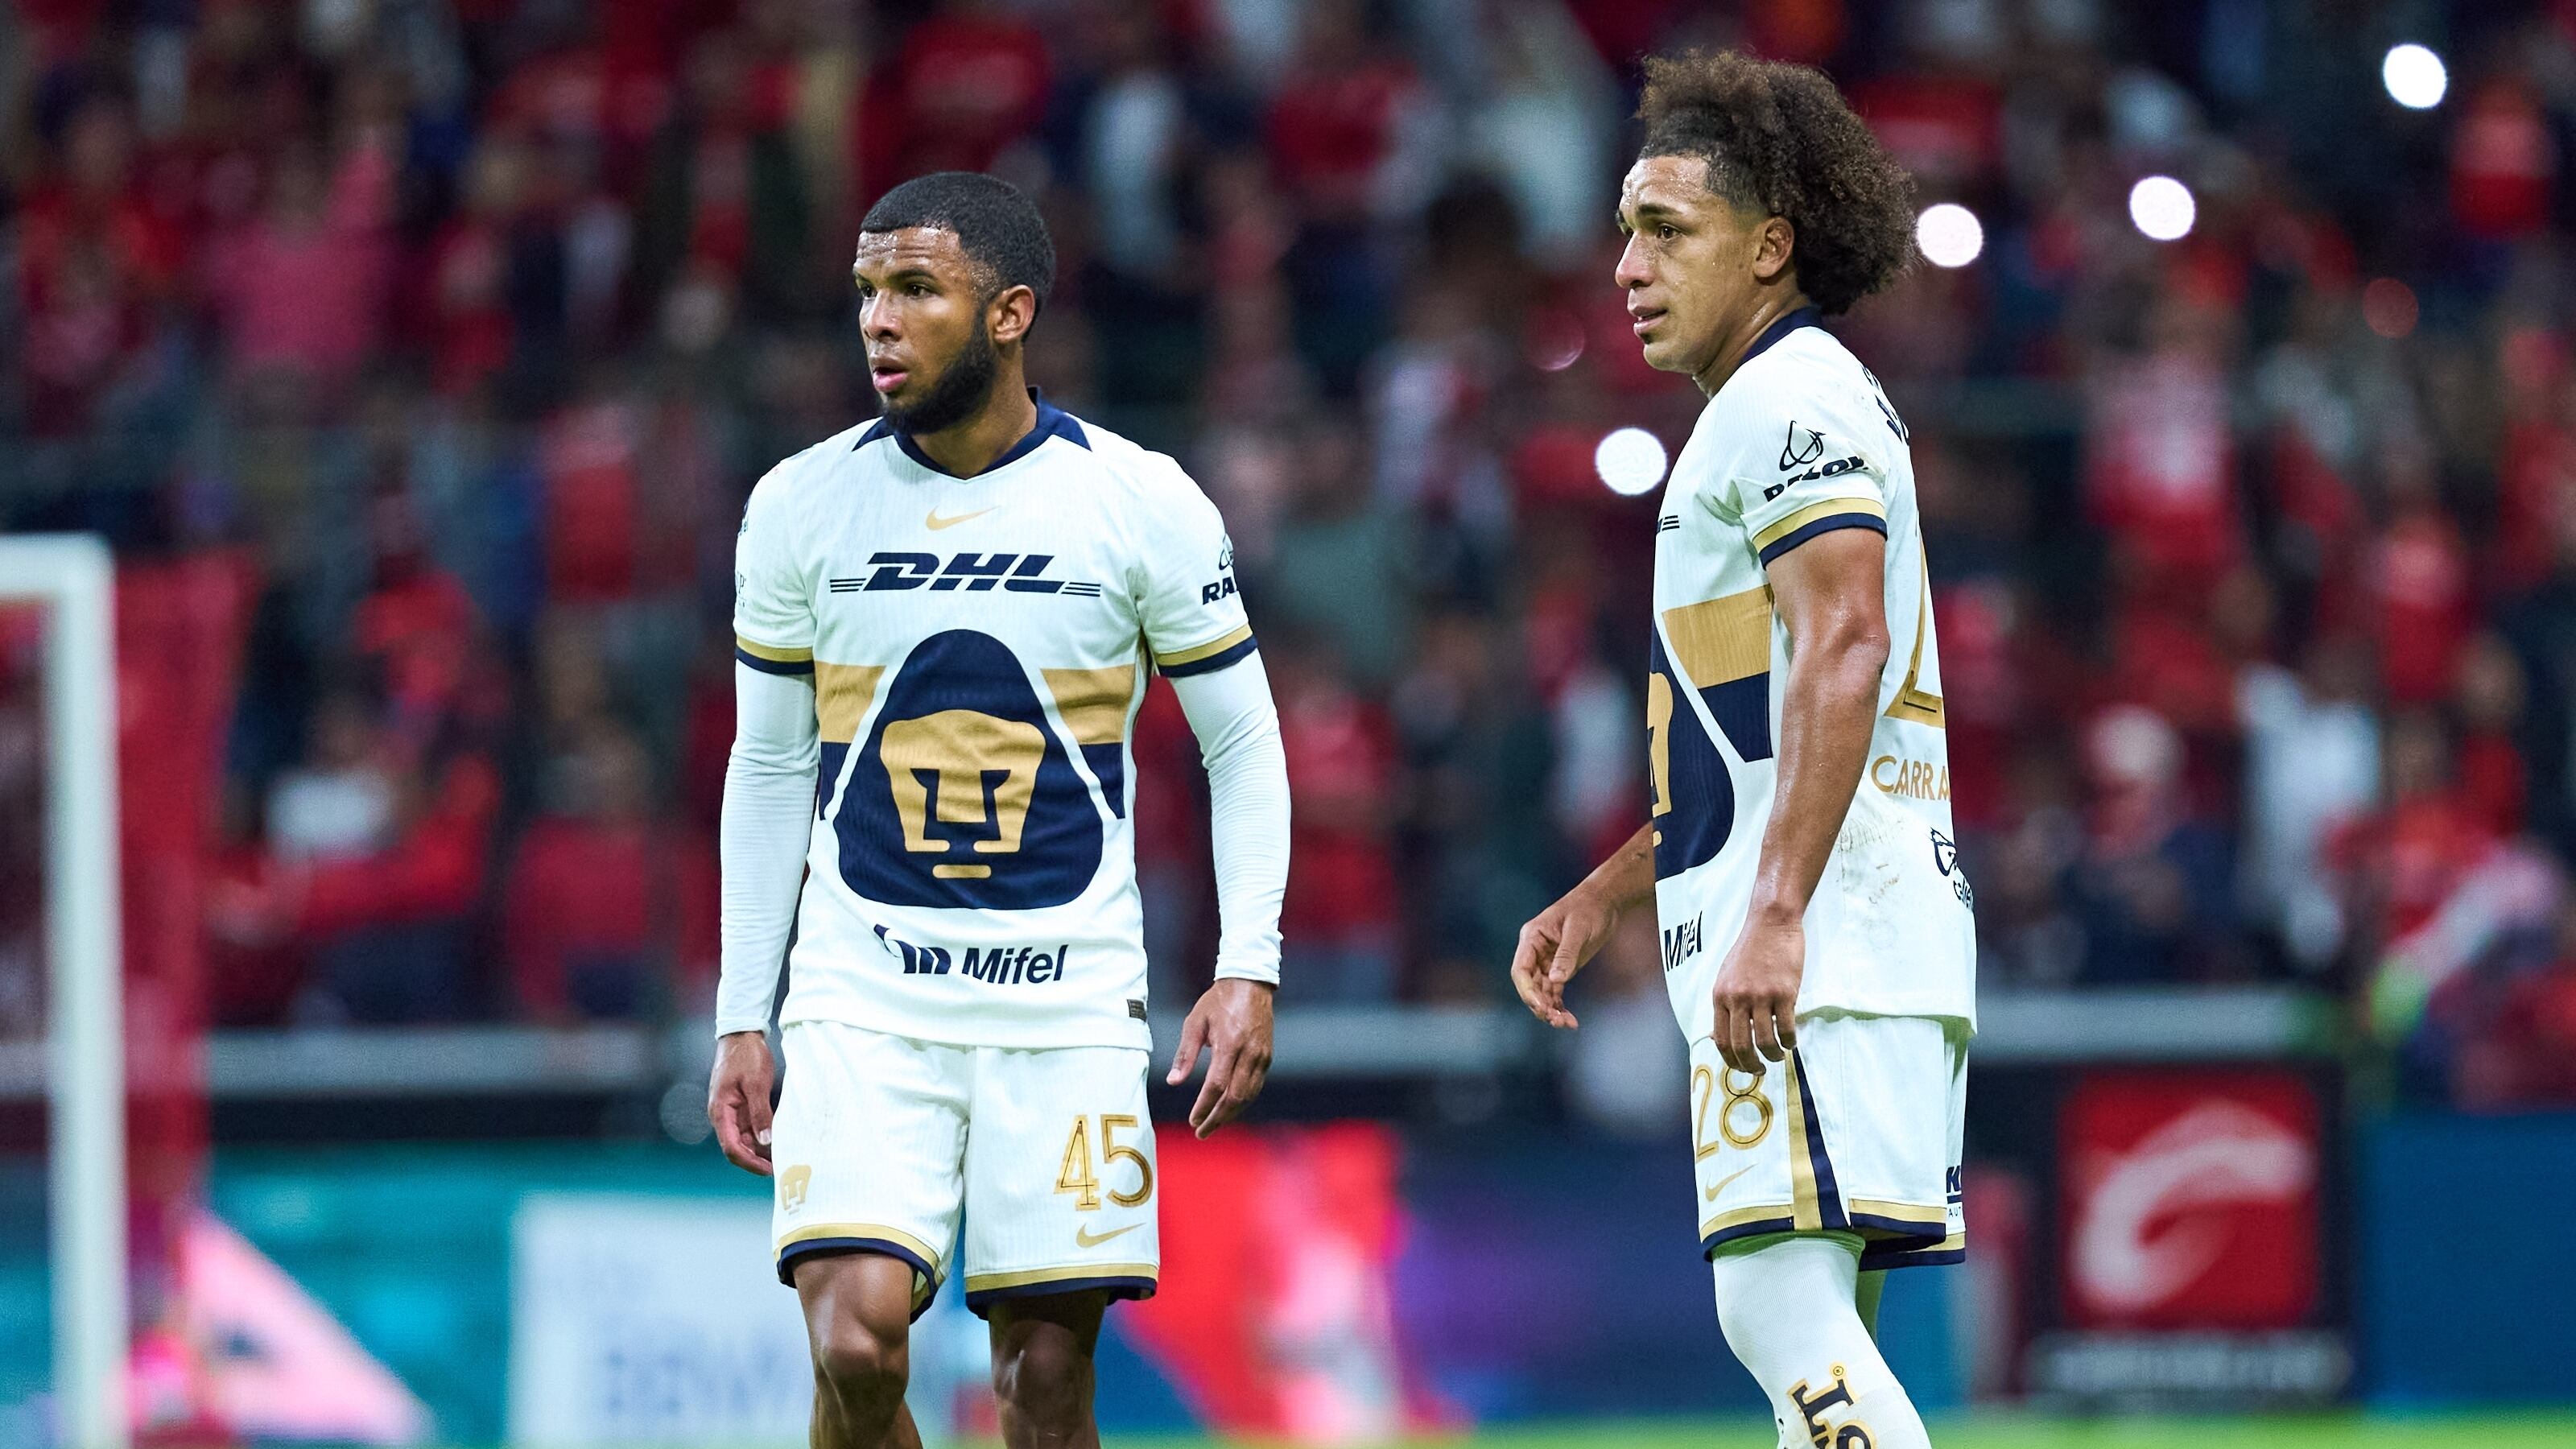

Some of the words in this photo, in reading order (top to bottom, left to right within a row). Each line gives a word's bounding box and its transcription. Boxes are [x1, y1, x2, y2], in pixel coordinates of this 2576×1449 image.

[863, 551, 1066, 594] DHL
[961, 943, 1069, 985] Mifel
[1691, 1063, 1774, 1164] 28
[1053, 1113, 1154, 1212] 45
